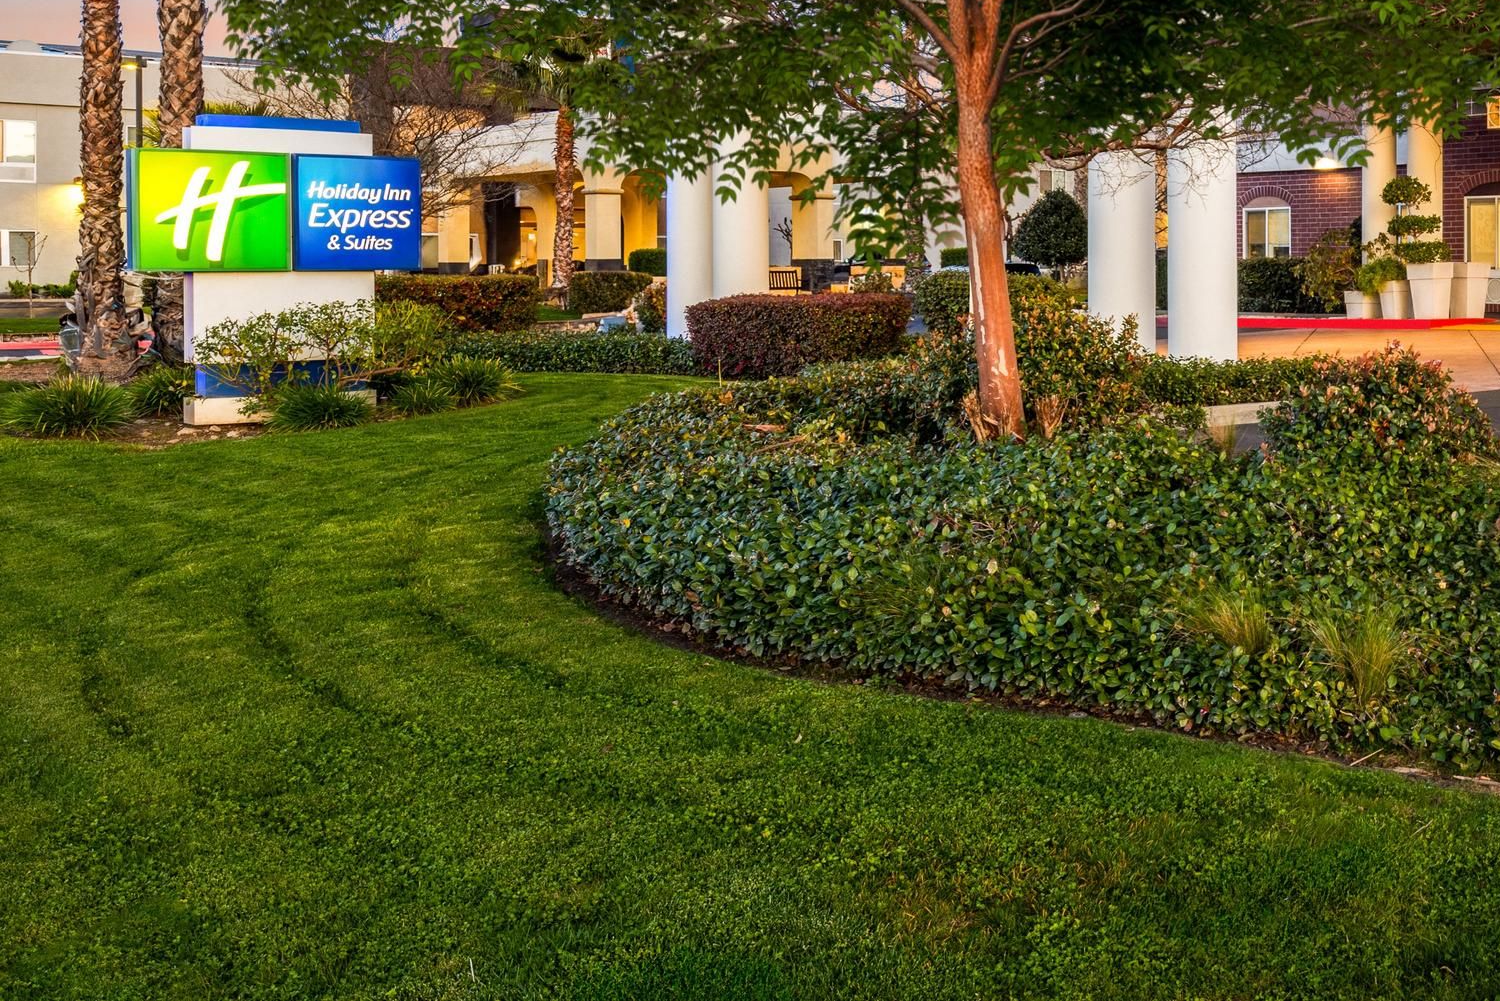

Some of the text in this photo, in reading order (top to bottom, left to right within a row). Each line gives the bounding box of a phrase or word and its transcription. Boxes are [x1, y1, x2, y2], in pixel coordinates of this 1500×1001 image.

[307, 180, 411, 204] Holiday Inn
[308, 203, 412, 233] Express
[327, 234, 393, 250] & Suites
